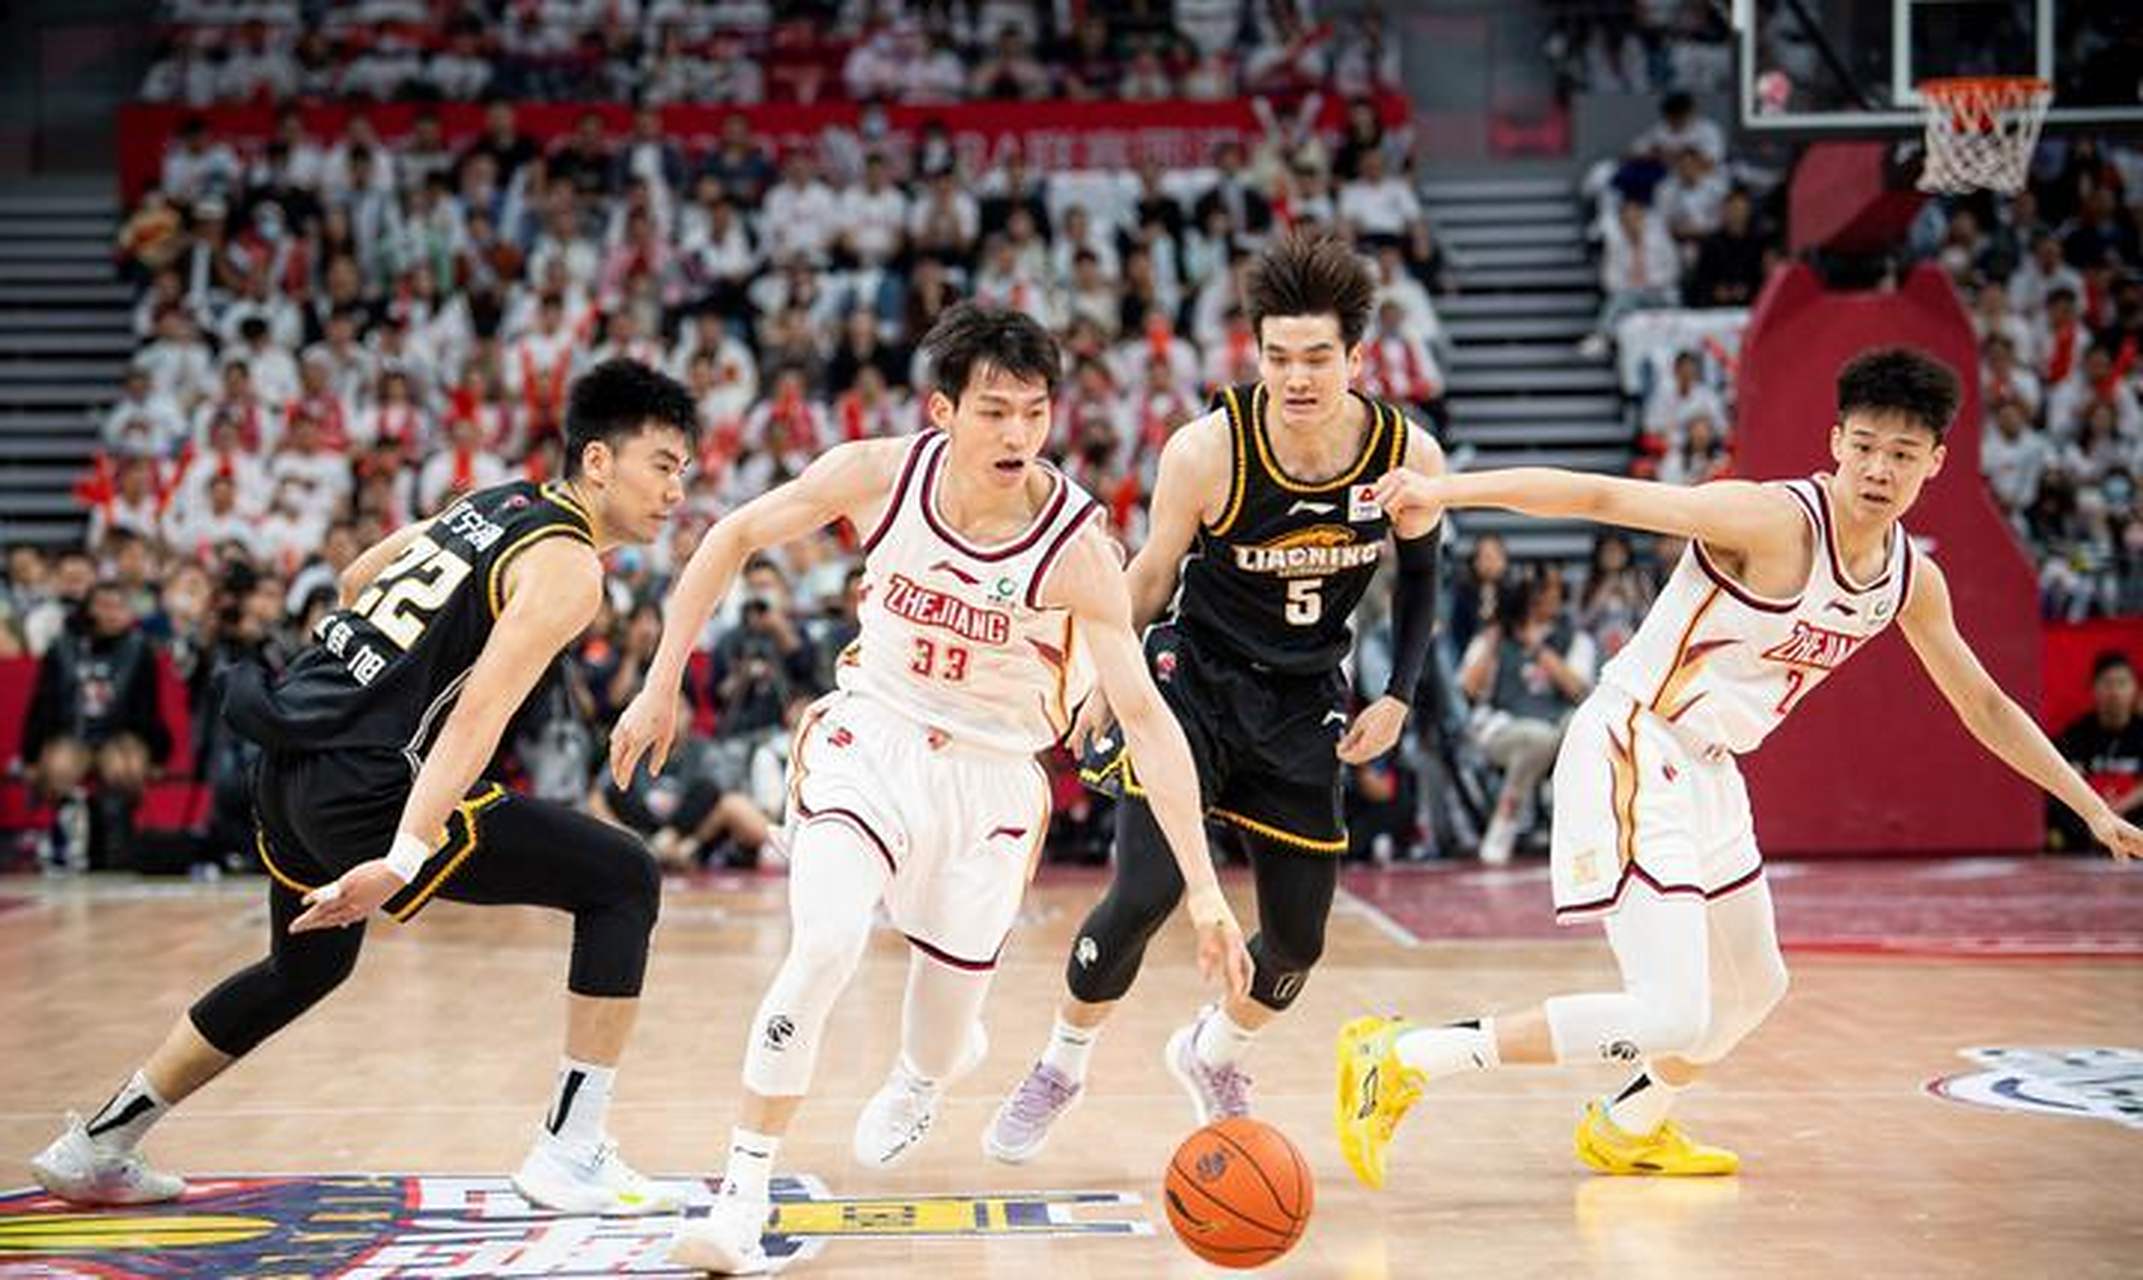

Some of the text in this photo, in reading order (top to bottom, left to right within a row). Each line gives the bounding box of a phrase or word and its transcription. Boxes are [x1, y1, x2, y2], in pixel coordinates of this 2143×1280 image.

[353, 535, 473, 650] 22
[885, 573, 1009, 644] ZHEJIANG
[1285, 578, 1323, 625] 5
[911, 638, 967, 681] 33
[1776, 670, 1803, 714] 2
